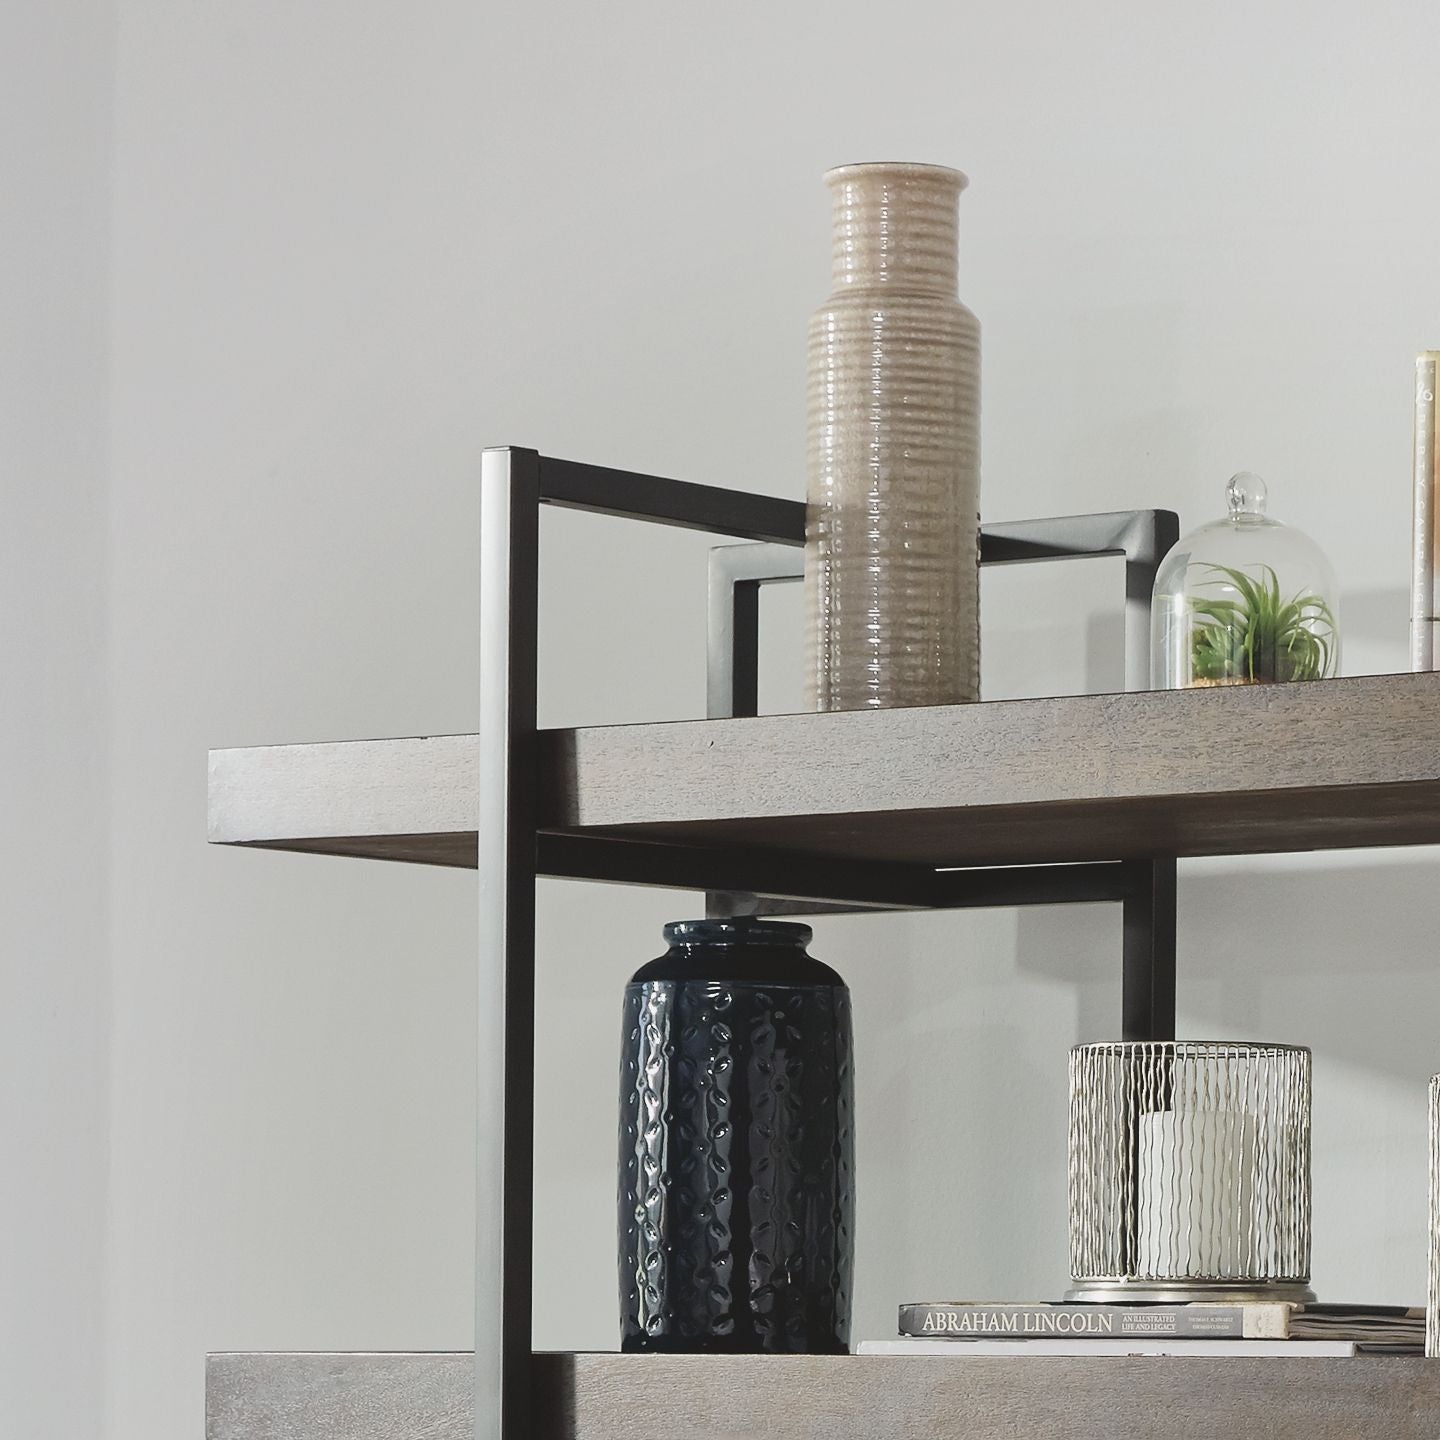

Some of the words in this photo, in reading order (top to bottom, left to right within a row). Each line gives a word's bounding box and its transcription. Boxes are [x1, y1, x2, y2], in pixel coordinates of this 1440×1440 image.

[922, 1311, 1019, 1333] ABRAHAM
[1023, 1312, 1114, 1334] LINCOLN
[1123, 1315, 1132, 1323] AN
[1132, 1315, 1176, 1323] ILLUSTRATED
[1122, 1323, 1134, 1331] LIFE
[1135, 1323, 1150, 1331] AND
[1151, 1323, 1177, 1331] LEGACY
